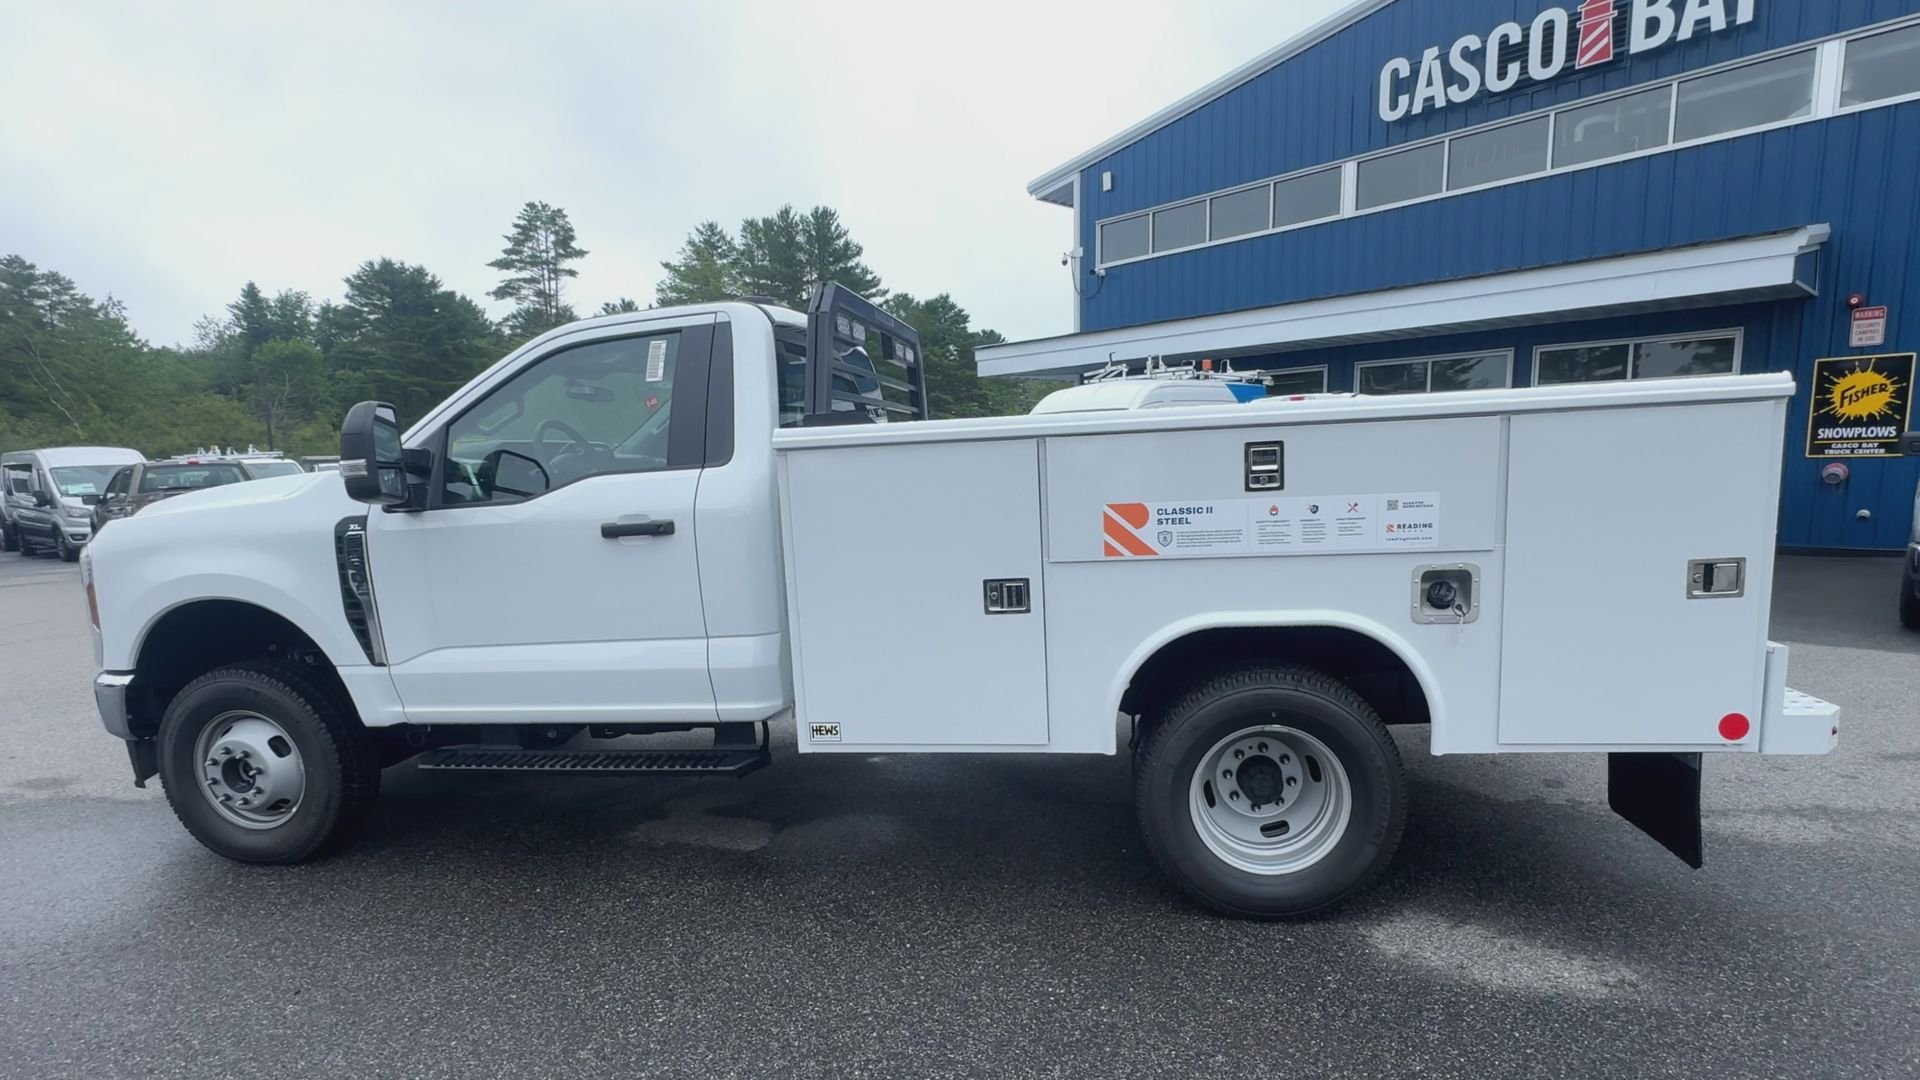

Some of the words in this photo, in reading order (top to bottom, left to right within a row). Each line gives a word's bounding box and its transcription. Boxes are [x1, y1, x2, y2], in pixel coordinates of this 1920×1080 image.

[1378, 7, 1569, 122] CASCO
[1817, 426, 1897, 439] SNOWPLOWS
[1156, 506, 1204, 516] CLASSIC
[1206, 506, 1213, 514] II
[1156, 517, 1192, 526] STEEL
[811, 725, 839, 739] HEWS
